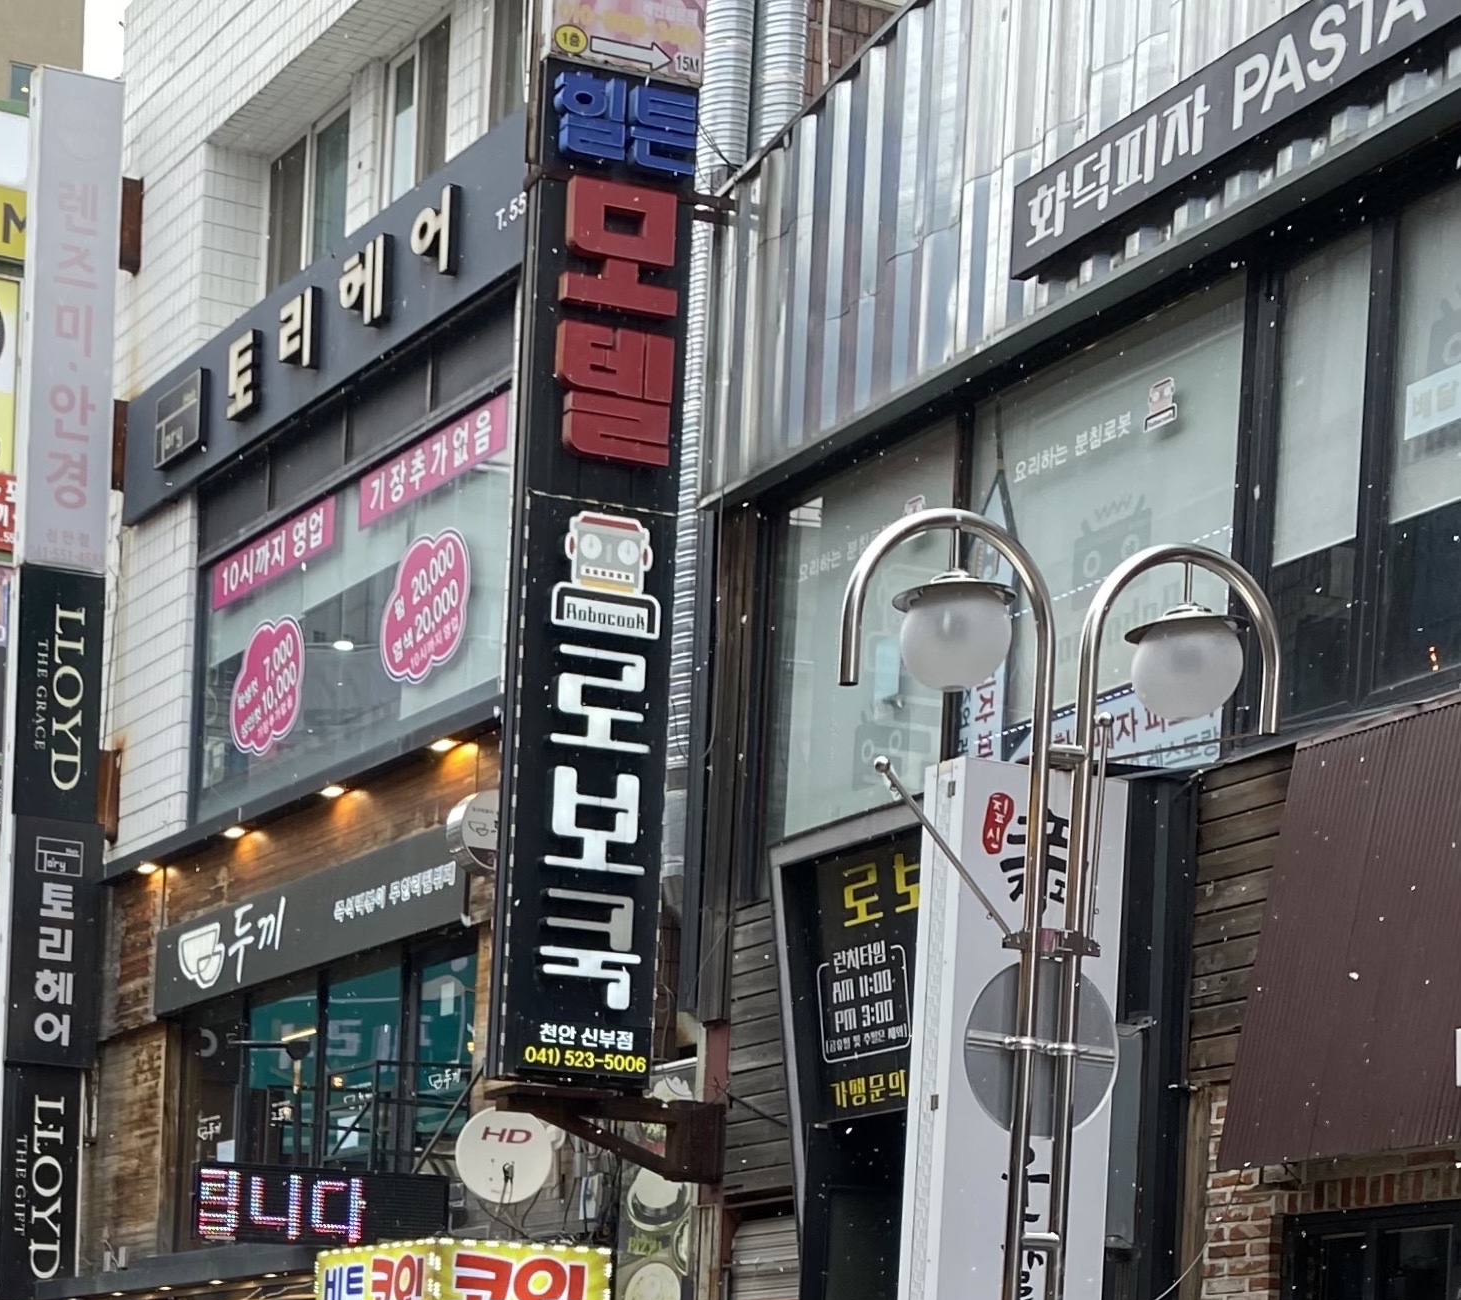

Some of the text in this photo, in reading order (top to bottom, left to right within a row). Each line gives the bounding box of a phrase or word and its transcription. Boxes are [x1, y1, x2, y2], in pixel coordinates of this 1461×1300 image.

[1025, 0, 1428, 248] 화덕피자 PASTA
[226, 183, 456, 421] 토리헤어
[558, 174, 678, 467] 모텔
[1012, 439, 1069, 484] 요리하는
[220, 507, 325, 597] 10시까지 영업
[410, 539, 456, 605] 20,000
[413, 577, 460, 642] 20,000
[566, 602, 648, 633] Robocook
[33, 639, 50, 751] THE GRACE
[50, 603, 88, 792] LLOYD
[538, 641, 652, 1012] 로보쿡
[33, 881, 75, 1048] 토리헤어
[227, 895, 287, 984] 두끼
[832, 939, 887, 976] 런치타임
[831, 968, 893, 1005] AM 11:00
[834, 998, 895, 1034] PM 3:00
[524, 1045, 648, 1075] 041) 523-5006
[539, 1021, 635, 1053] 천안 신부점
[829, 1068, 907, 1109] 가맹문의
[480, 1125, 533, 1145] HD
[10, 1134, 28, 1237] THE GIFT
[29, 1095, 65, 1280] LLOYD
